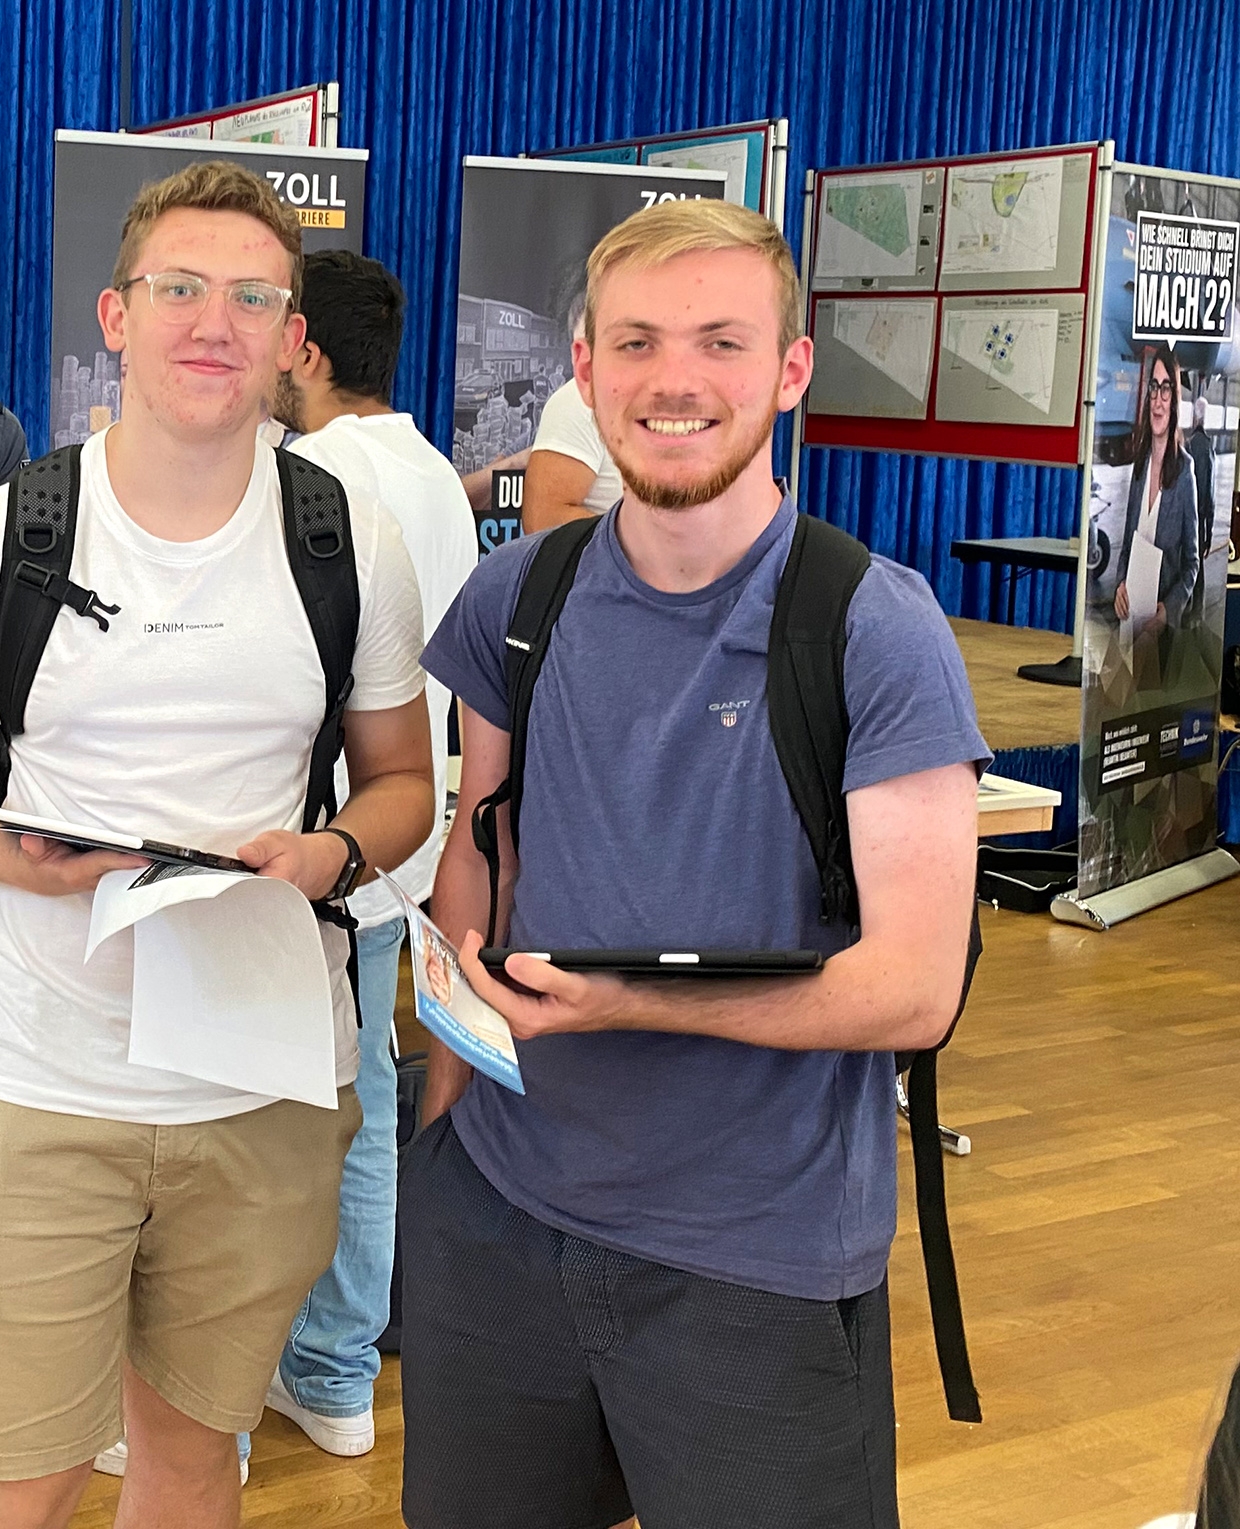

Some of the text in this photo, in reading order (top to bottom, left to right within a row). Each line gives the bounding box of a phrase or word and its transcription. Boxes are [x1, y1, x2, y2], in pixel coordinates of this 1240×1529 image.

[1142, 223, 1235, 251] WIE SCHNELL BRINGT DICH
[1140, 246, 1233, 277] DEIN STUDIUM AUF
[1137, 273, 1200, 330] MACH
[1202, 279, 1232, 331] 2?
[498, 310, 525, 329] ZOLL
[144, 623, 184, 633] DENIM
[708, 700, 750, 711] GANT
